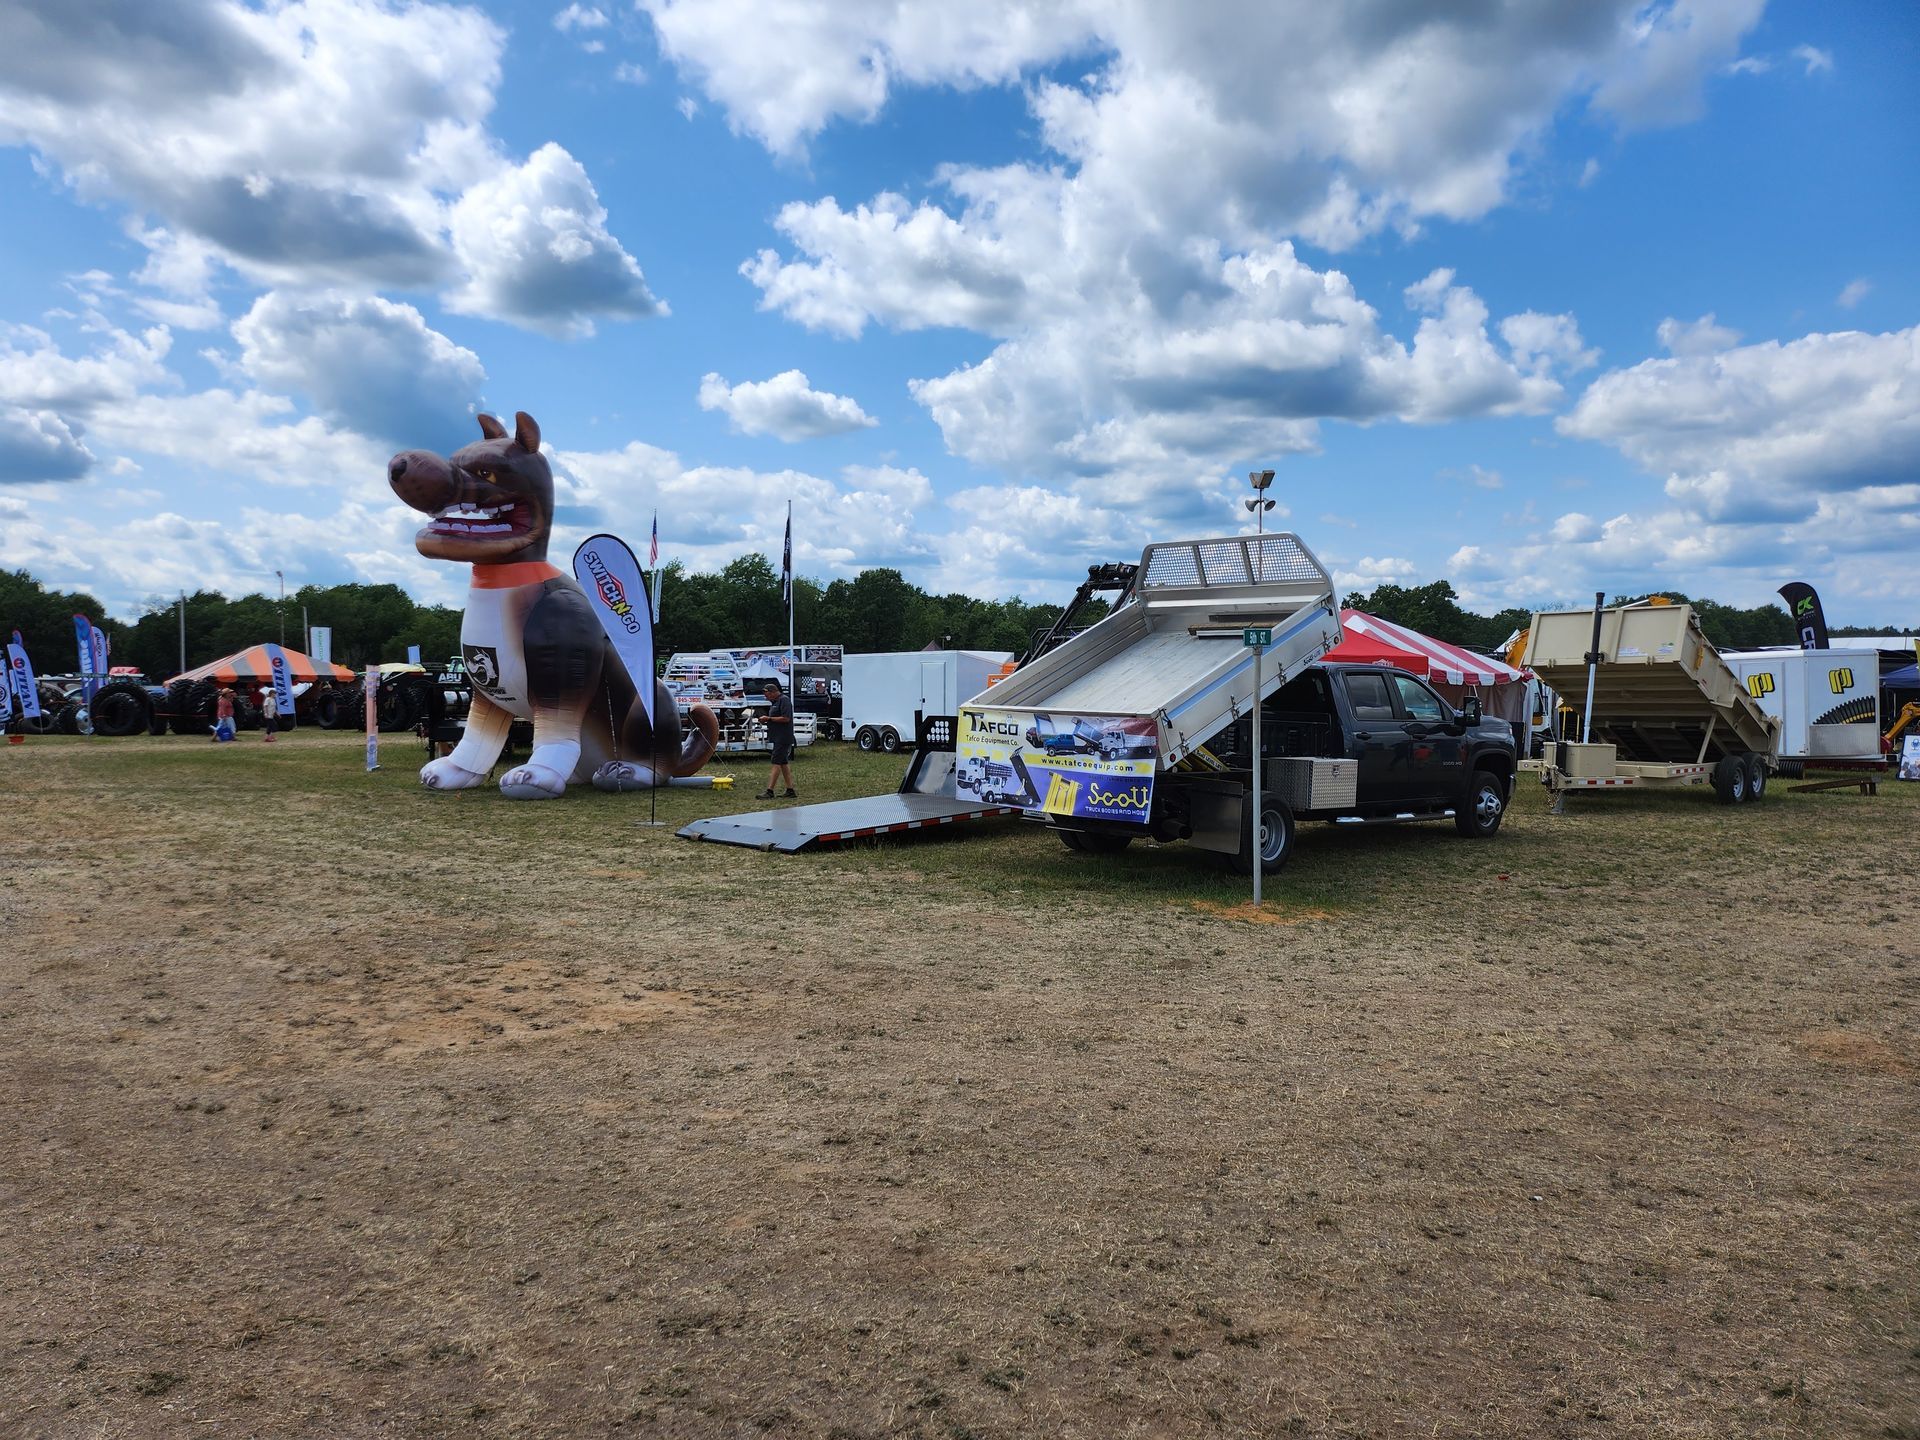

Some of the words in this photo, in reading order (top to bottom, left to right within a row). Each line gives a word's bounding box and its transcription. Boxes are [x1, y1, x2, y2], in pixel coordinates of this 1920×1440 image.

[16, 669, 35, 710] TITAN
[273, 666, 289, 708] TITAN
[963, 711, 1019, 736] TAFCO
[966, 734, 980, 742] Tafco
[981, 736, 1010, 746] Equipment
[1041, 758, 1133, 772] www.tafcoequip.com
